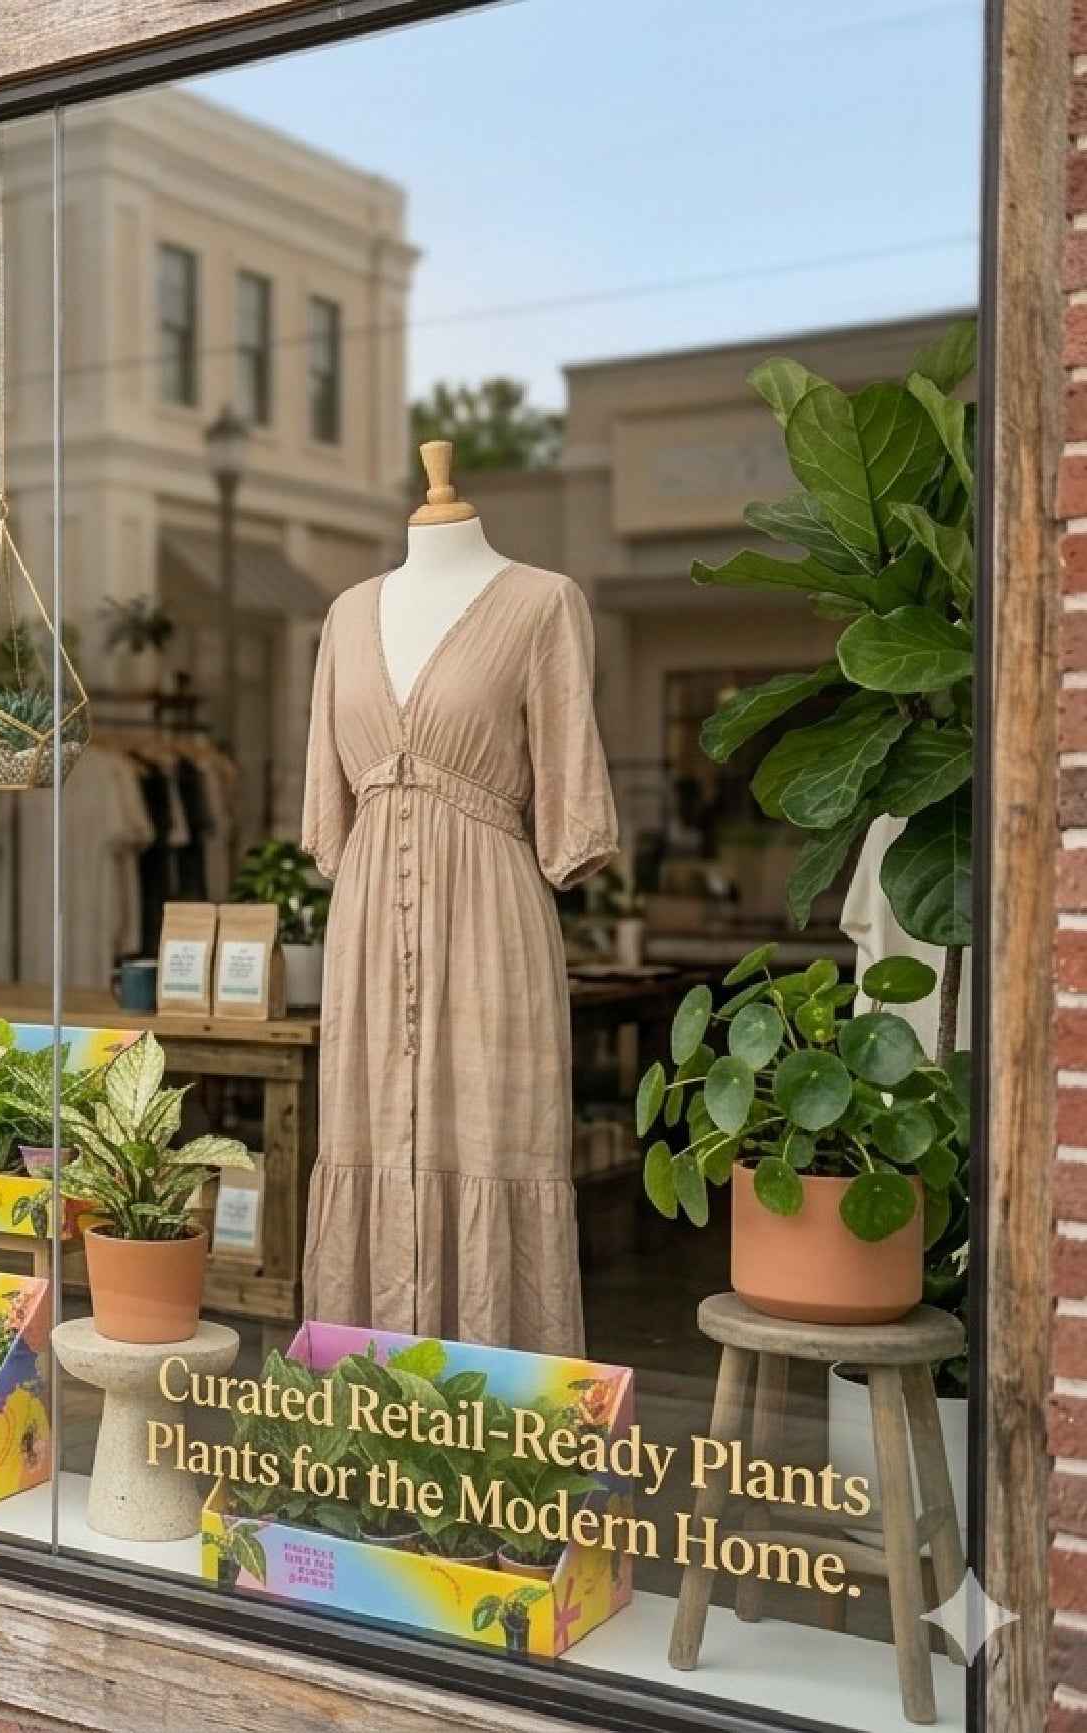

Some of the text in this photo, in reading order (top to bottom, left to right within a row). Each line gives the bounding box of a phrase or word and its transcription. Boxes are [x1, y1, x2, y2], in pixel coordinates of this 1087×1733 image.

[146, 1421, 862, 1599] Plants for the Modern Home.
[158, 1356, 872, 1517] Curated Retail-Ready Plants
